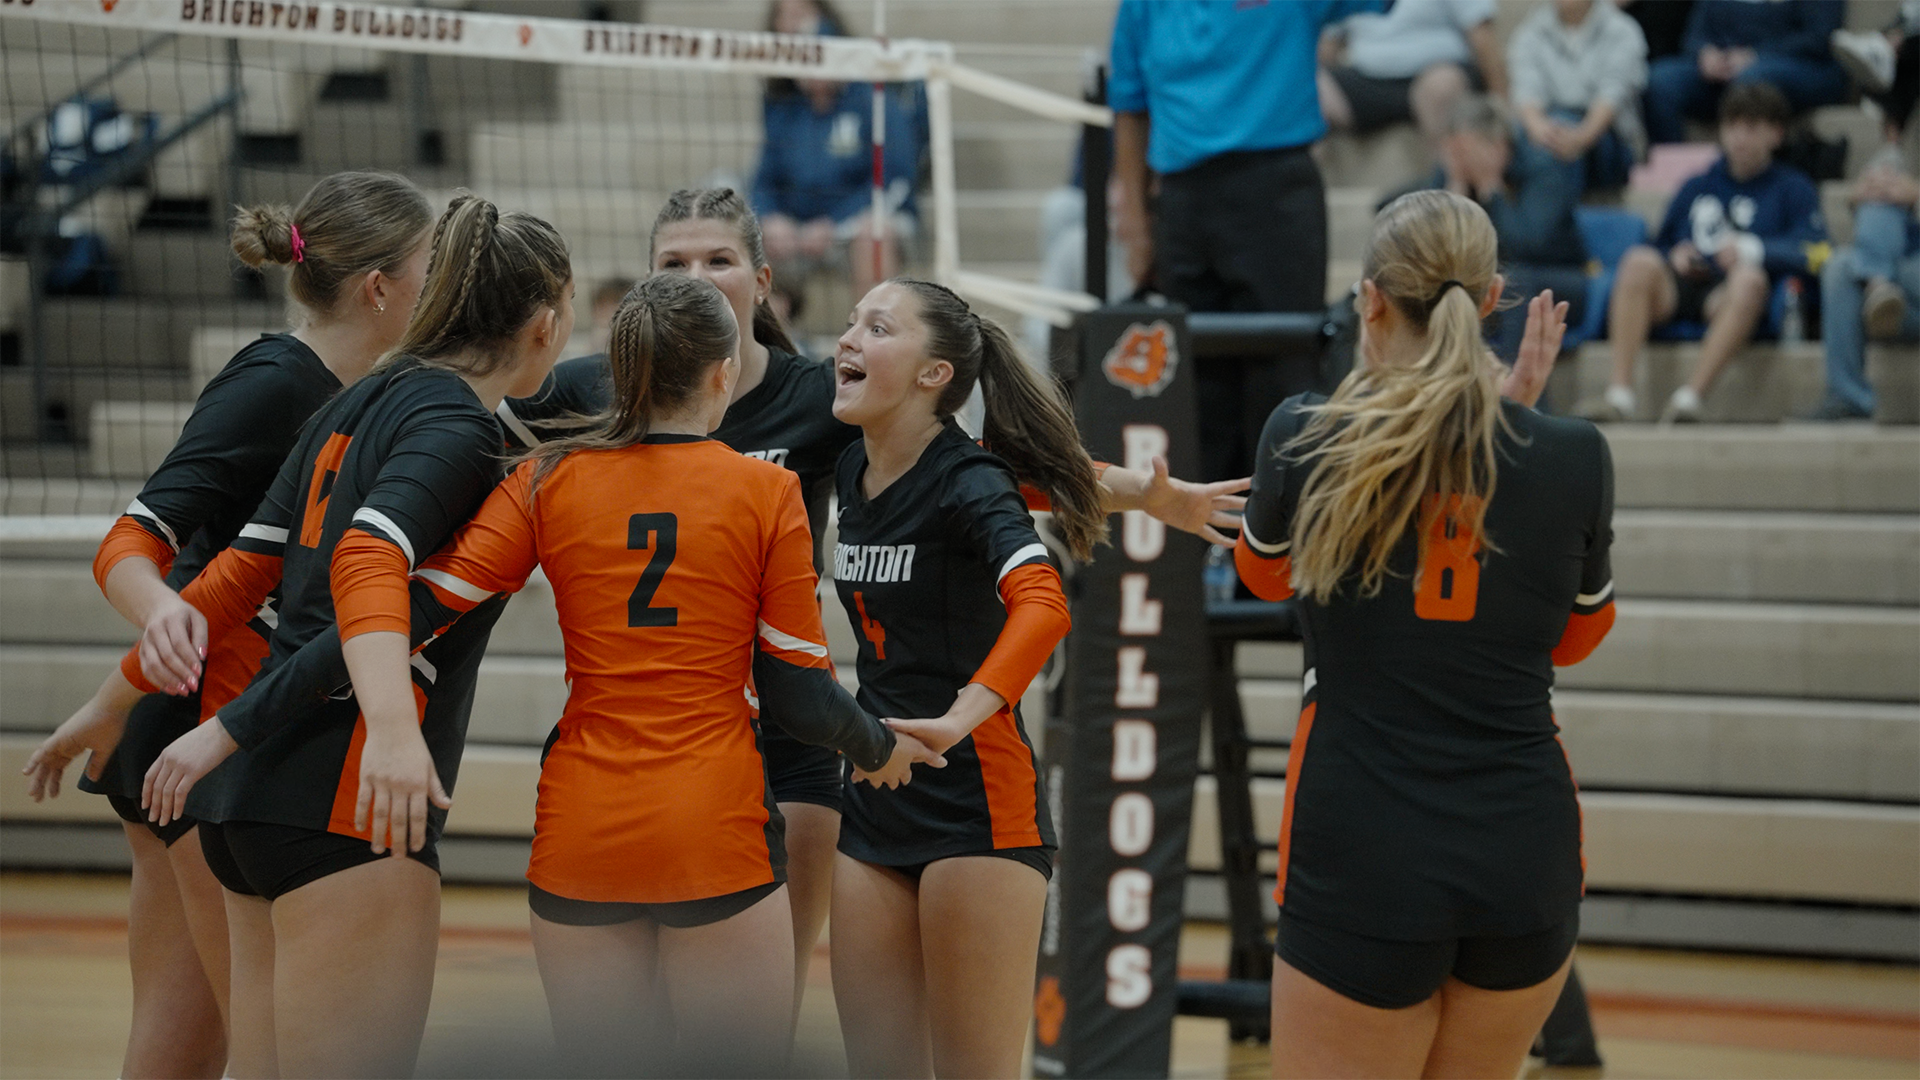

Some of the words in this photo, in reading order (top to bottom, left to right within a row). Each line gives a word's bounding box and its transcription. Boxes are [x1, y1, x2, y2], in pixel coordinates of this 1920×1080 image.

[181, 0, 319, 30] BRIGHTON
[333, 7, 464, 41] BULLDOGS
[627, 512, 678, 627] 2
[833, 542, 916, 583] RIGHTON
[1414, 493, 1484, 622] 8
[853, 591, 887, 661] 4
